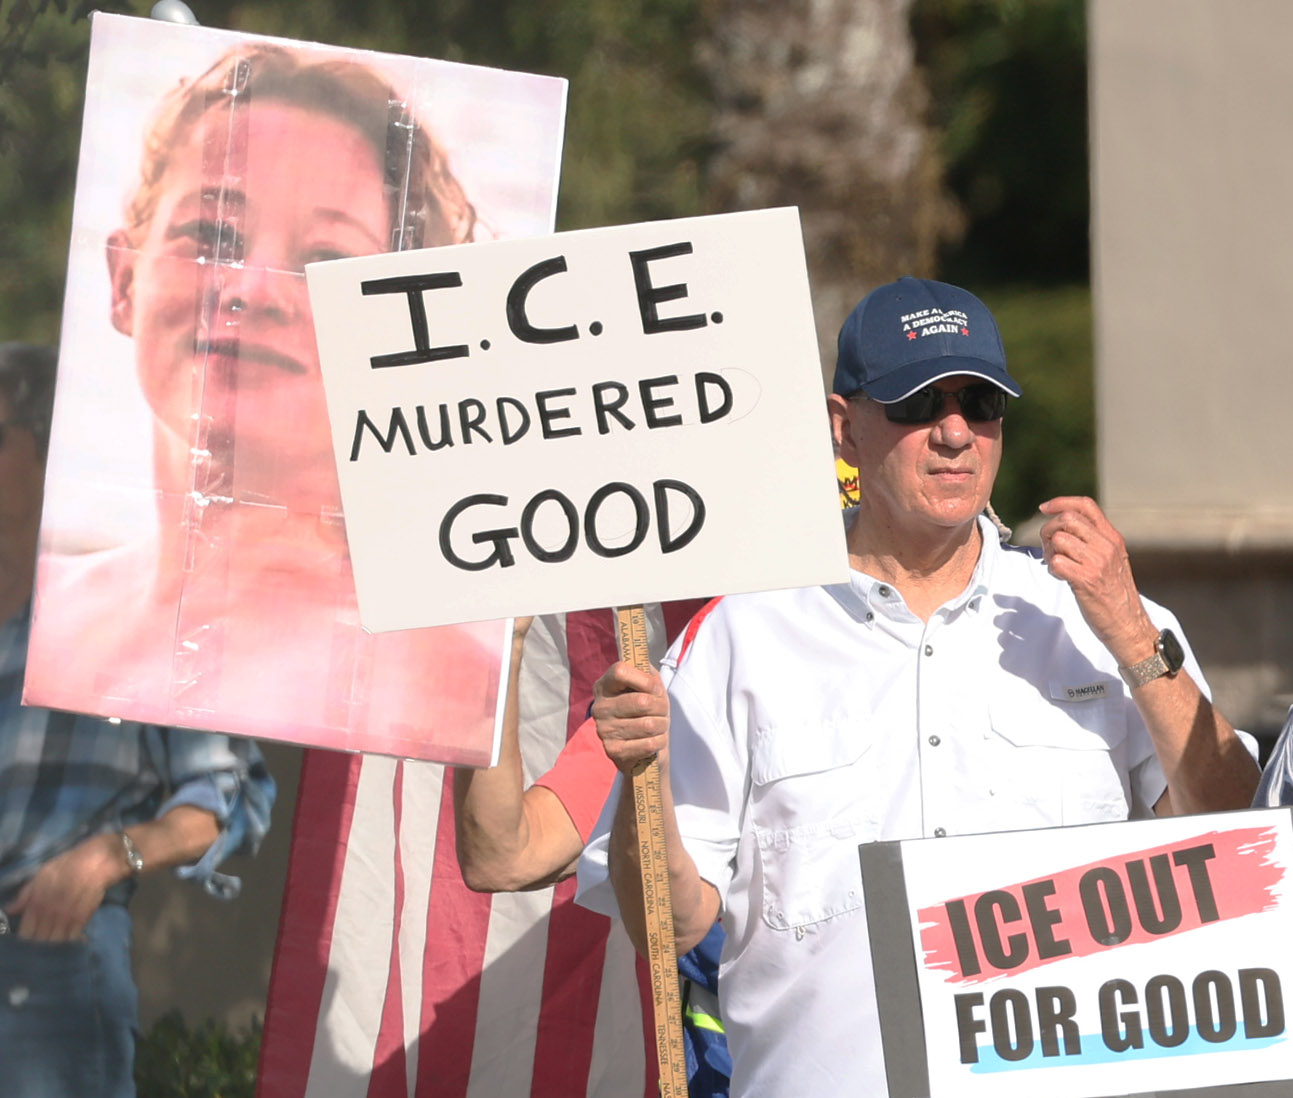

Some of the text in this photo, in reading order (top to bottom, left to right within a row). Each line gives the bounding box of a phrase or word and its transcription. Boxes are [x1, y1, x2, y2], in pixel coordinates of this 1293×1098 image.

[361, 242, 723, 368] I.C.E.
[901, 309, 929, 323] MAKE
[903, 323, 911, 331] A
[921, 324, 959, 337] AGAIN
[350, 371, 733, 462] MURDERED
[439, 479, 706, 571] GOOD
[632, 615, 640, 625] 10
[620, 621, 632, 662] ALABAMA
[634, 639, 642, 648] 11
[647, 781, 656, 790] 17
[635, 786, 647, 824] MISSOURI
[652, 828, 660, 837] 19
[641, 840, 651, 870] NORTH
[654, 851, 662, 860] 20
[656, 873, 664, 882] 21
[644, 873, 655, 915] CAROLINA
[945, 843, 1220, 977] ICE OUT
[660, 920, 668, 930] 23
[649, 932, 660, 961] SOUTH
[662, 945, 670, 954] 24
[664, 968, 672, 978] 25
[652, 963, 663, 1006] CAROLINA
[666, 992, 675, 1002] 26
[954, 968, 1287, 1064] FOR GOOD
[657, 1024, 669, 1065] TENNESSEE
[670, 1038, 678, 1049] 28
[672, 1062, 680, 1072] 29
[674, 1085, 682, 1095] 30
